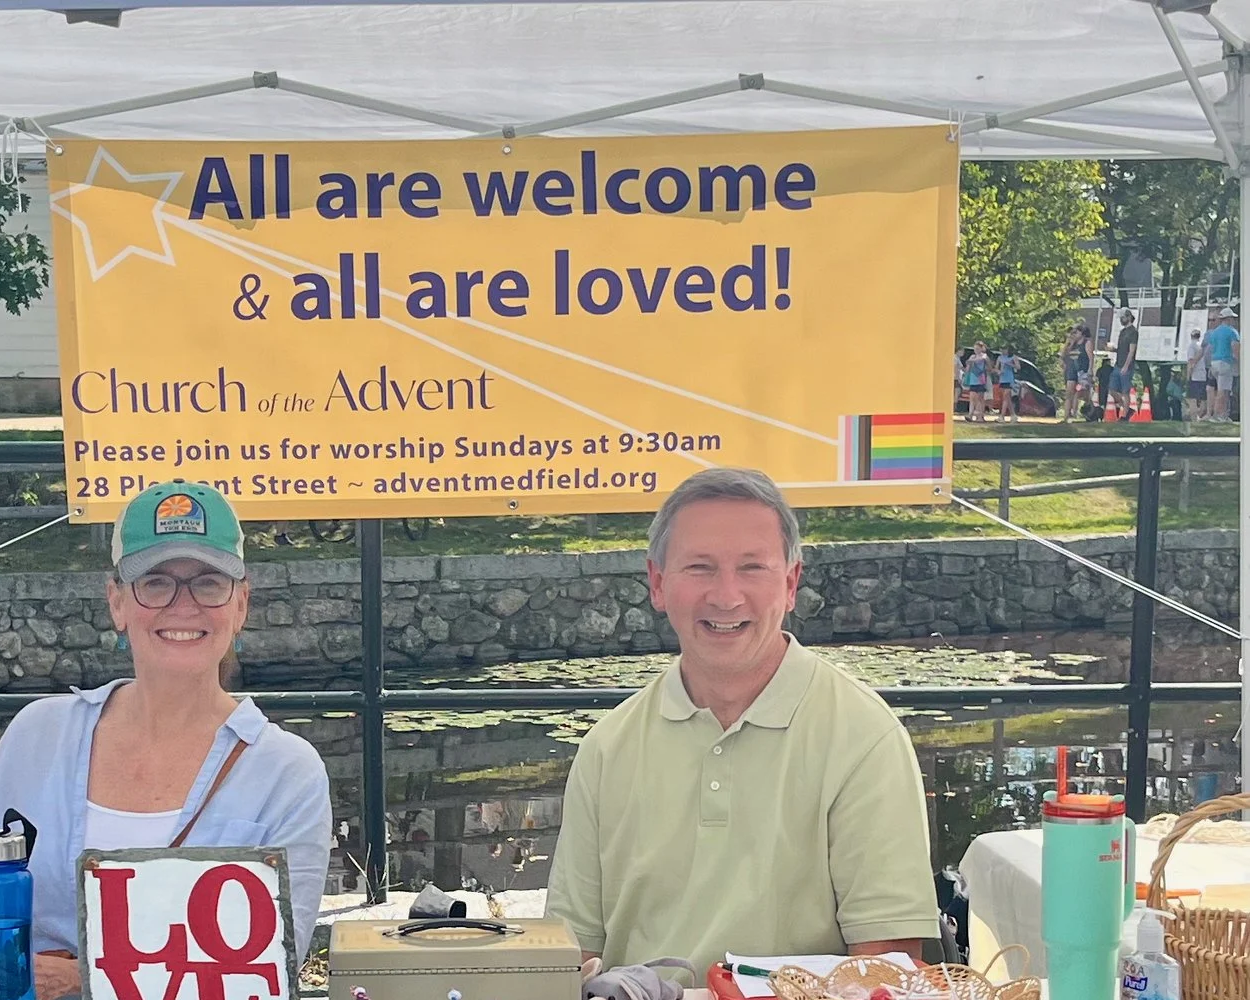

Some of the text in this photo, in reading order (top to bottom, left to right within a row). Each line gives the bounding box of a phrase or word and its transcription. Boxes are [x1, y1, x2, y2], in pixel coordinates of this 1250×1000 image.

[188, 150, 816, 220] All are welcome
[233, 245, 791, 320] & all are loved!
[71, 365, 495, 417] Church of the Advent
[75, 432, 721, 467] Please join us for worship Sundays at 9:30am
[77, 477, 109, 498] 28
[120, 475, 241, 495] Plnt
[253, 475, 337, 495] Street
[374, 468, 657, 492] adventmedfield.org
